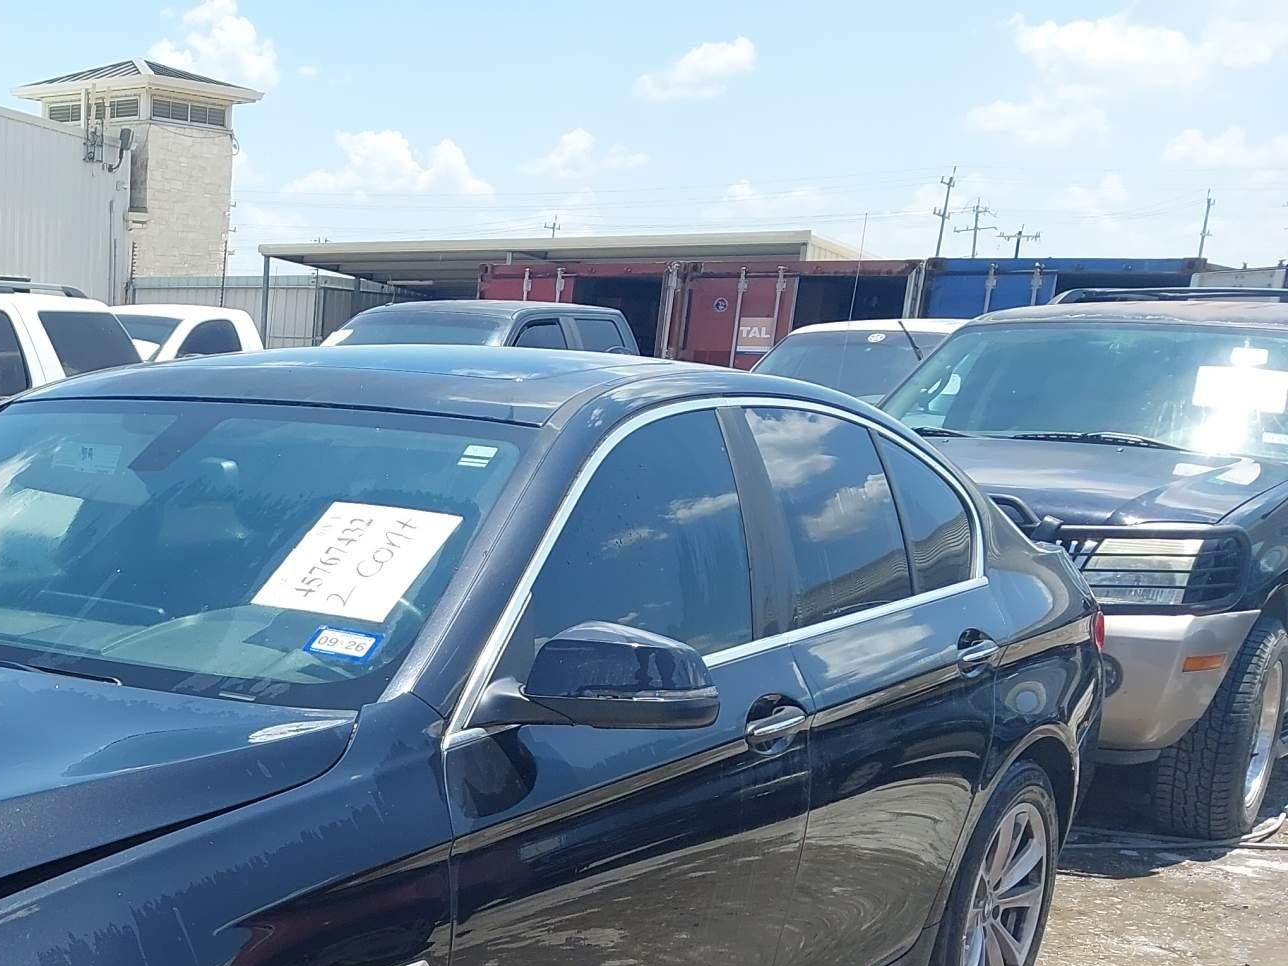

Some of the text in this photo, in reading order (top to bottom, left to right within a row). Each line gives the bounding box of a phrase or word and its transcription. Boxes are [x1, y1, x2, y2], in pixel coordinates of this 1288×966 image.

[739, 326, 770, 338] TAL
[317, 635, 367, 652] 09 26
